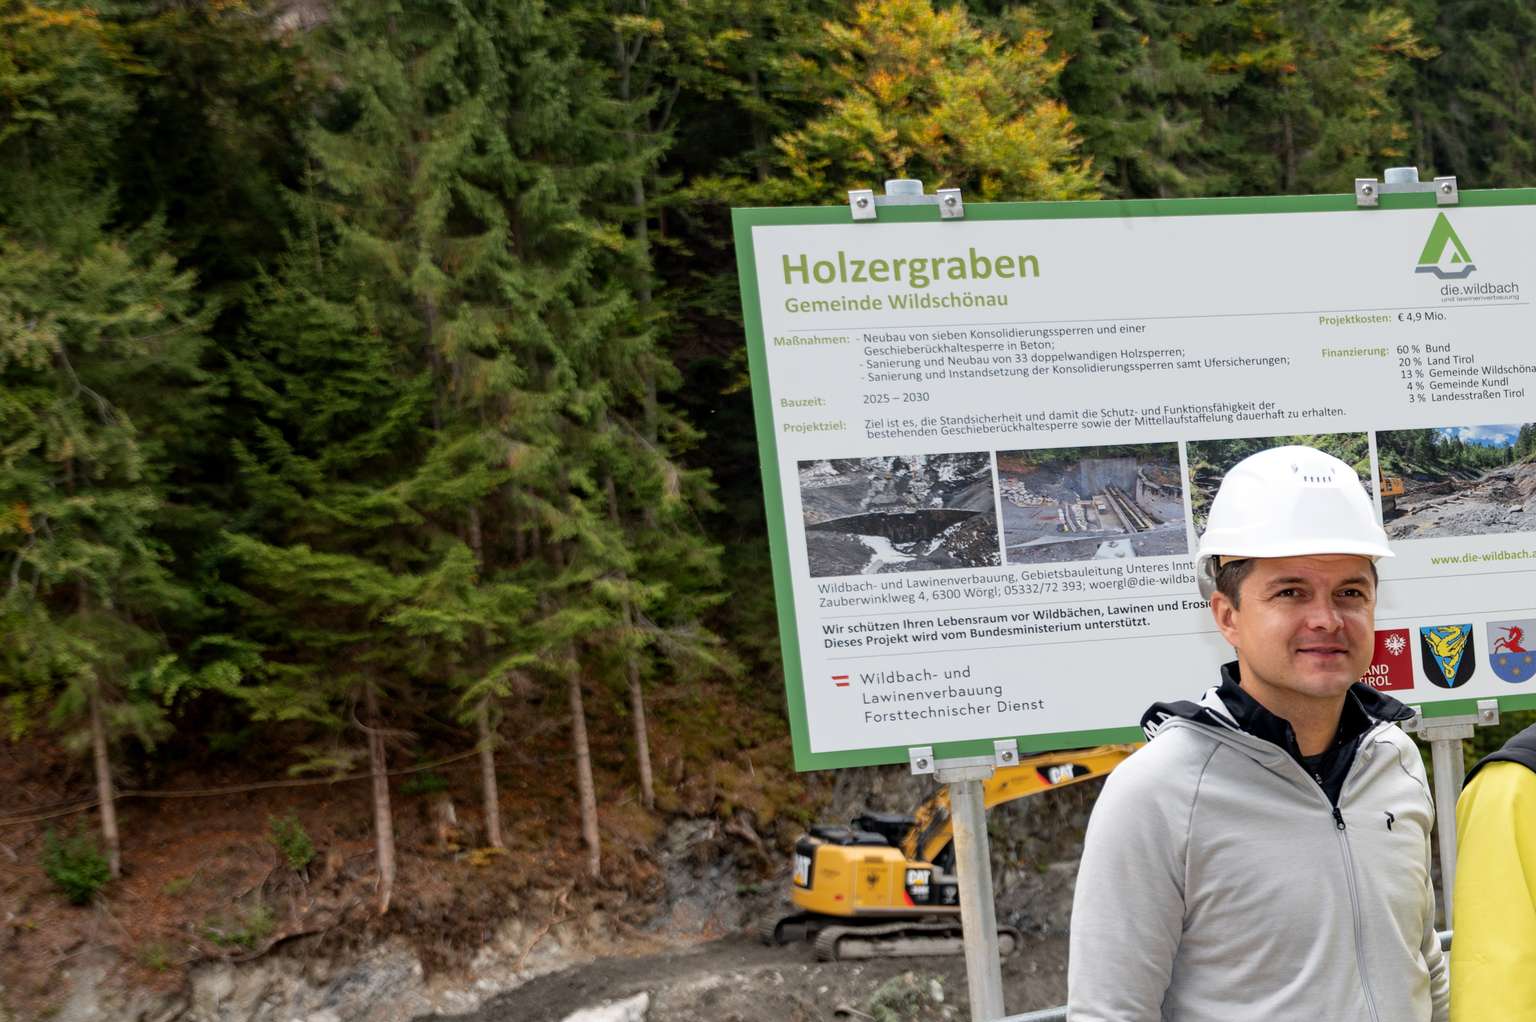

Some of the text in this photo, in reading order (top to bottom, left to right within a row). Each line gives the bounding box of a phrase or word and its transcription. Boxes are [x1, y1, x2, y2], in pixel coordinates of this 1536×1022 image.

[782, 248, 1040, 290] Holzergraben
[1440, 281, 1519, 296] die.wildbach
[784, 290, 1008, 313] Gemeinde Wildschönau
[1318, 313, 1392, 326] Projektkosten:
[1397, 311, 1446, 322] € 4,9 Mio.
[773, 335, 850, 346] Maßnahmen:
[863, 323, 1146, 343] Neubau von sieben Konsolidierungssperren und einer
[863, 340, 1054, 356] Geschieberückhaltesperre in Beton;
[1321, 346, 1389, 357] Finanzierung:
[1396, 343, 1450, 354] 60 % Bund
[866, 348, 1185, 369] Sanierung und Neubau von 33 doppelwandigen Holzsperren;
[1398, 354, 1474, 367] 20 % Land Tirol
[867, 356, 1290, 382] Sanierung und Instandsetzung der Konsolidierungssperren samt Ufersicherungen;
[1400, 369, 1413, 379] 13
[1414, 369, 1424, 378] %
[1428, 366, 1479, 378] Gemeinde
[1406, 376, 1509, 390] 4 % Gemeinde Kundl
[780, 396, 826, 407] Bauzeit:
[863, 392, 930, 404] 2025 2030
[1408, 387, 1524, 403] 3 % Landesstraßen Tirol
[864, 400, 1276, 429] Ziel ist es, die Standsicherheit und damit die Schutz- und Funktionsfähigkeit der
[866, 427, 938, 439] bestehenden
[940, 421, 1078, 436] Geschieberückhaltesperre
[1081, 418, 1111, 428] sowie
[1114, 417, 1131, 427] der
[1134, 412, 1234, 426] Mittellaufstaffelung
[1236, 409, 1285, 421] dauerhaft
[1301, 406, 1347, 417] erhalten.
[783, 420, 846, 434] Projektziel:
[817, 580, 877, 594] Wildbach-
[880, 578, 903, 590] und
[906, 573, 1018, 588] Lawinenverbauung,
[1020, 565, 1124, 581] Gebietsbauleitung
[1125, 563, 1170, 574] Unteres
[819, 592, 916, 608] Zauberwinklweg
[918, 591, 929, 603] 4,
[932, 588, 961, 600] 6300
[963, 586, 1001, 599] Wörgl;
[1004, 582, 1058, 595] 05332/72
[1061, 580, 1086, 592] 393;
[822, 624, 844, 635] Wir
[847, 621, 900, 633] schützen
[902, 618, 934, 629] Ihren
[936, 614, 1008, 627] Lebensraum
[1010, 613, 1030, 622] vor
[1032, 606, 1104, 620] Wildbächen,
[1107, 603, 1154, 615] Lawinen
[1157, 600, 1179, 611] und
[824, 615, 1150, 648] Dieses Projekt wird vom Bundesministerium unterstützt.
[859, 666, 970, 686] Wildbach- und
[862, 685, 1002, 705] Lawinenverbauung
[864, 697, 1044, 723] Forsttechnischer Dienst
[1048, 763, 1074, 784] CAT
[907, 868, 930, 885] CAT
